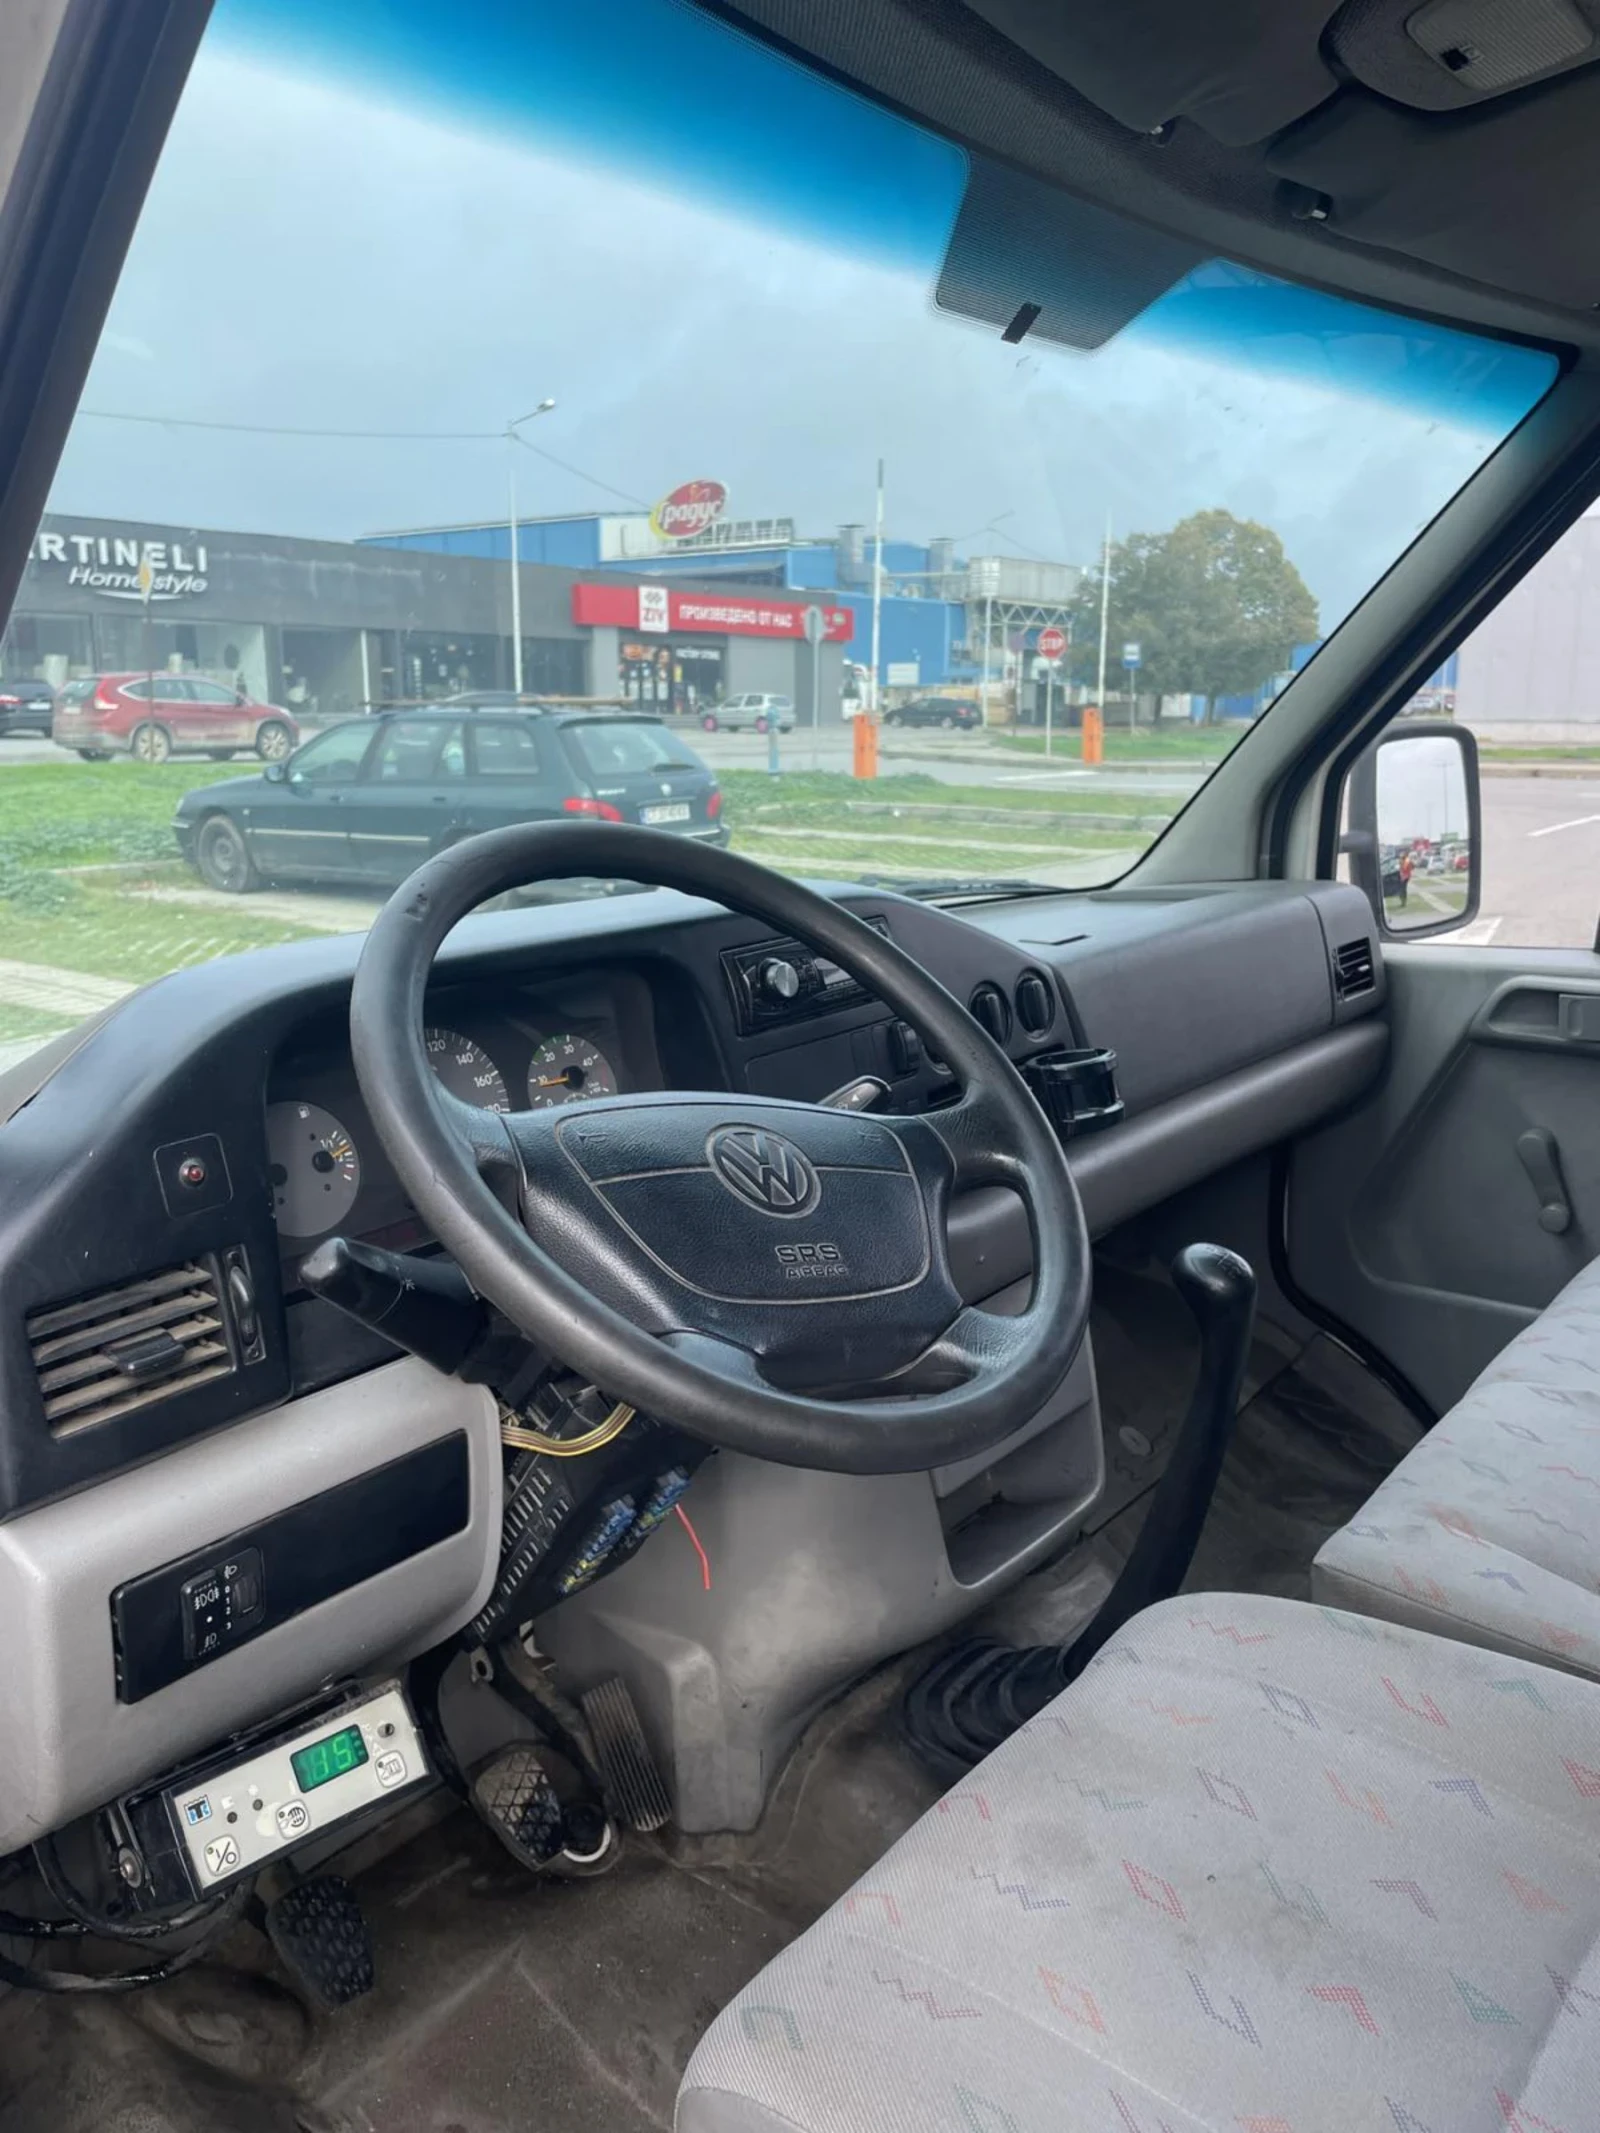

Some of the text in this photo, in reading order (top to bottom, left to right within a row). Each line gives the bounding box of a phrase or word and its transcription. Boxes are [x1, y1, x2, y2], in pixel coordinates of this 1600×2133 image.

[679, 604, 757, 624] ПРОИЗВЕДЕНО
[1040, 637, 1063, 651] STOP
[427, 1039, 446, 1053] 120
[563, 1043, 575, 1055] 30
[455, 1052, 474, 1066] 140
[544, 1052, 556, 1063] 20
[582, 1057, 593, 1068] 40
[473, 1076, 493, 1089] 160
[775, 1243, 841, 1263] SRS
[786, 1264, 848, 1280] AIRBAG
